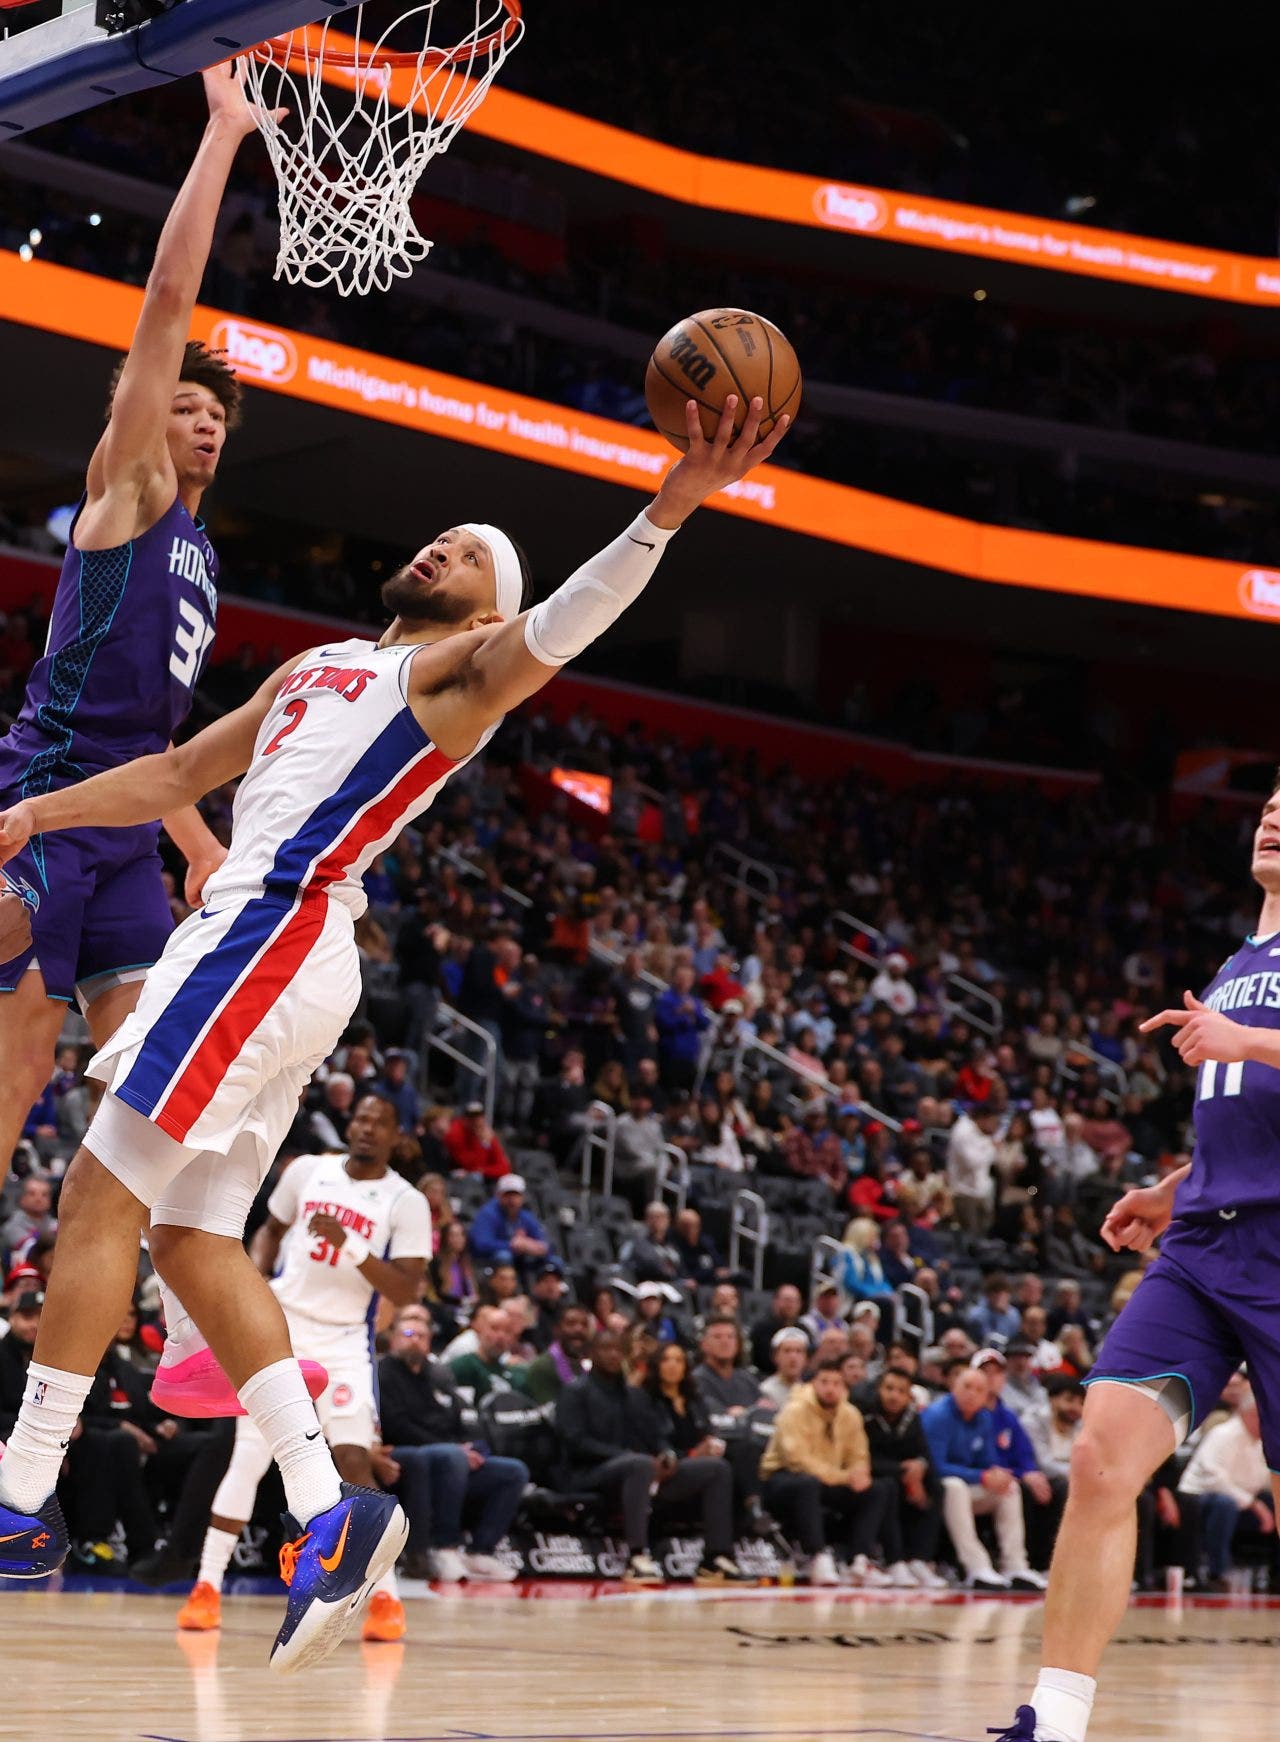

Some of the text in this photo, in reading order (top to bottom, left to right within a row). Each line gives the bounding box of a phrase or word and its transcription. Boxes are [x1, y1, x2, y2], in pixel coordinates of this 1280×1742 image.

[226, 321, 288, 378] hap
[307, 356, 417, 407] Michigan's
[417, 386, 475, 424] home
[475, 402, 506, 431] for
[507, 410, 569, 449] health
[262, 698, 308, 757] 2
